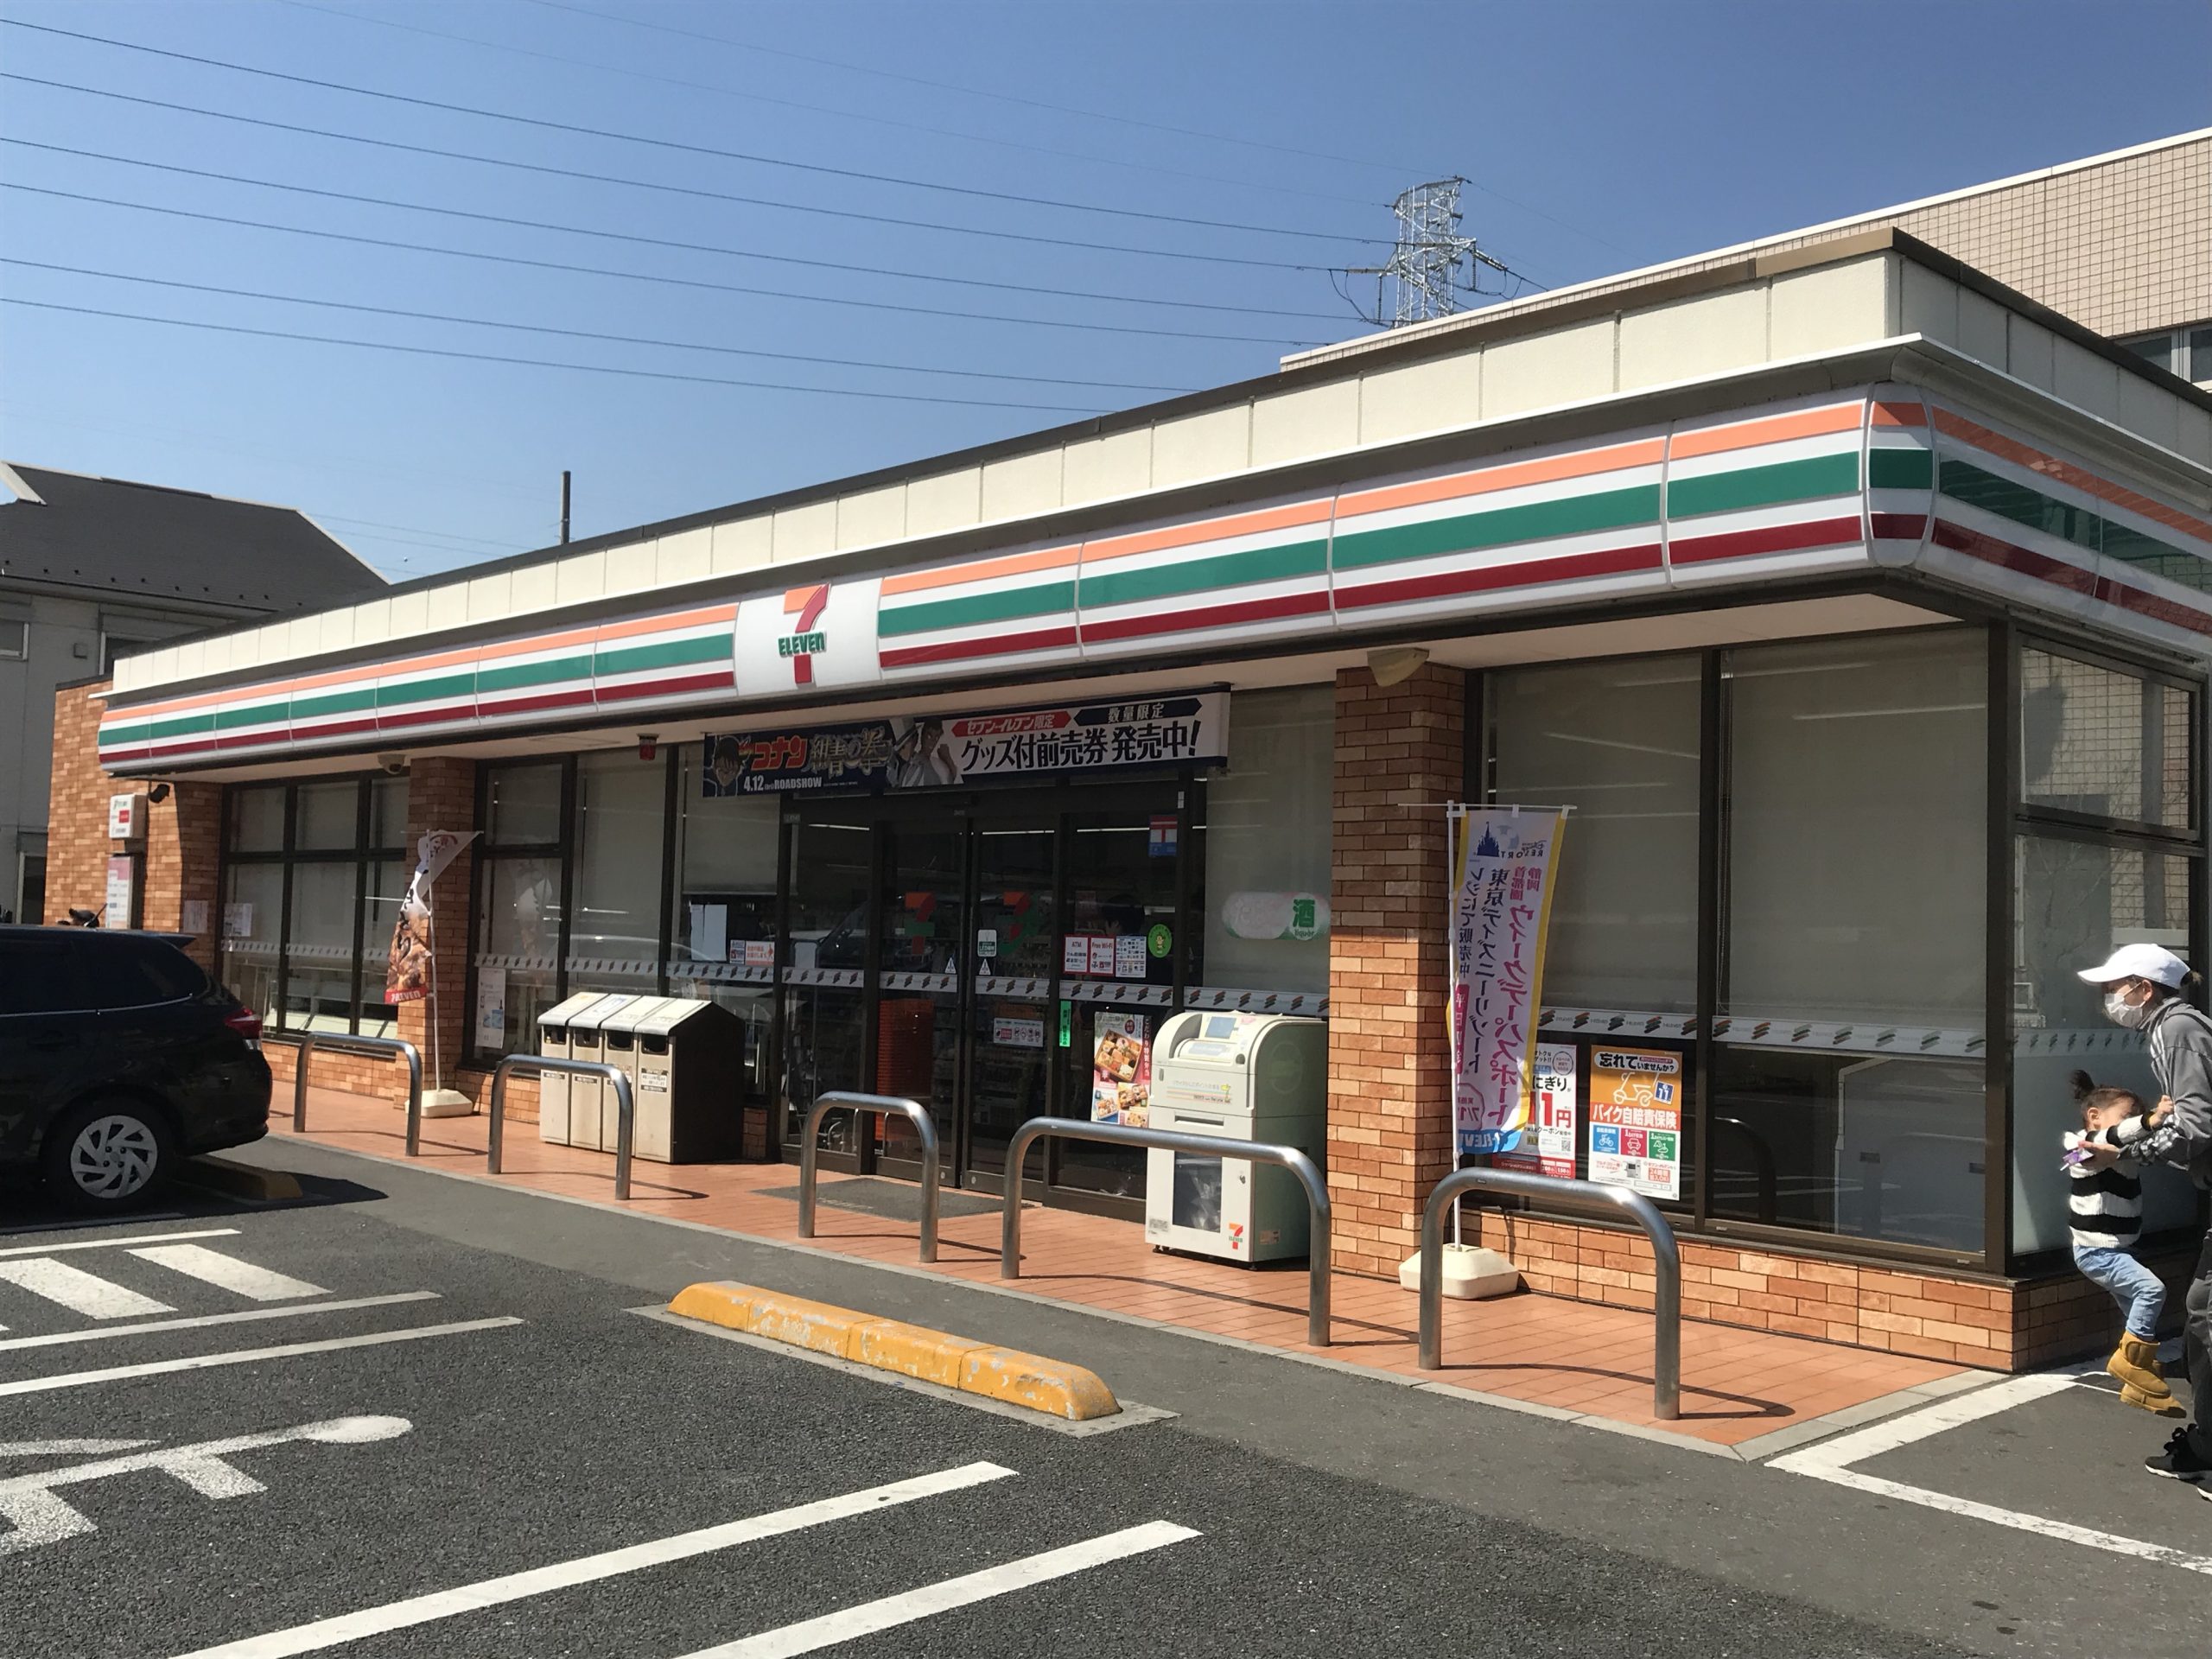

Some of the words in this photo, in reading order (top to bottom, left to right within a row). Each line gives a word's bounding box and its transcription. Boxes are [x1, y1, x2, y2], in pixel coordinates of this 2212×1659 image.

[1108, 702, 1165, 724] 数量限定
[751, 734, 808, 771] コナン
[961, 728, 1108, 772] グッズ付前売券
[1112, 720, 1202, 762] 発売中!
[744, 775, 765, 791] 4.12
[774, 776, 823, 790] ROADSHOW
[1293, 899, 1315, 927] 酒
[1592, 1103, 1676, 1129] バイク自賠責保険
